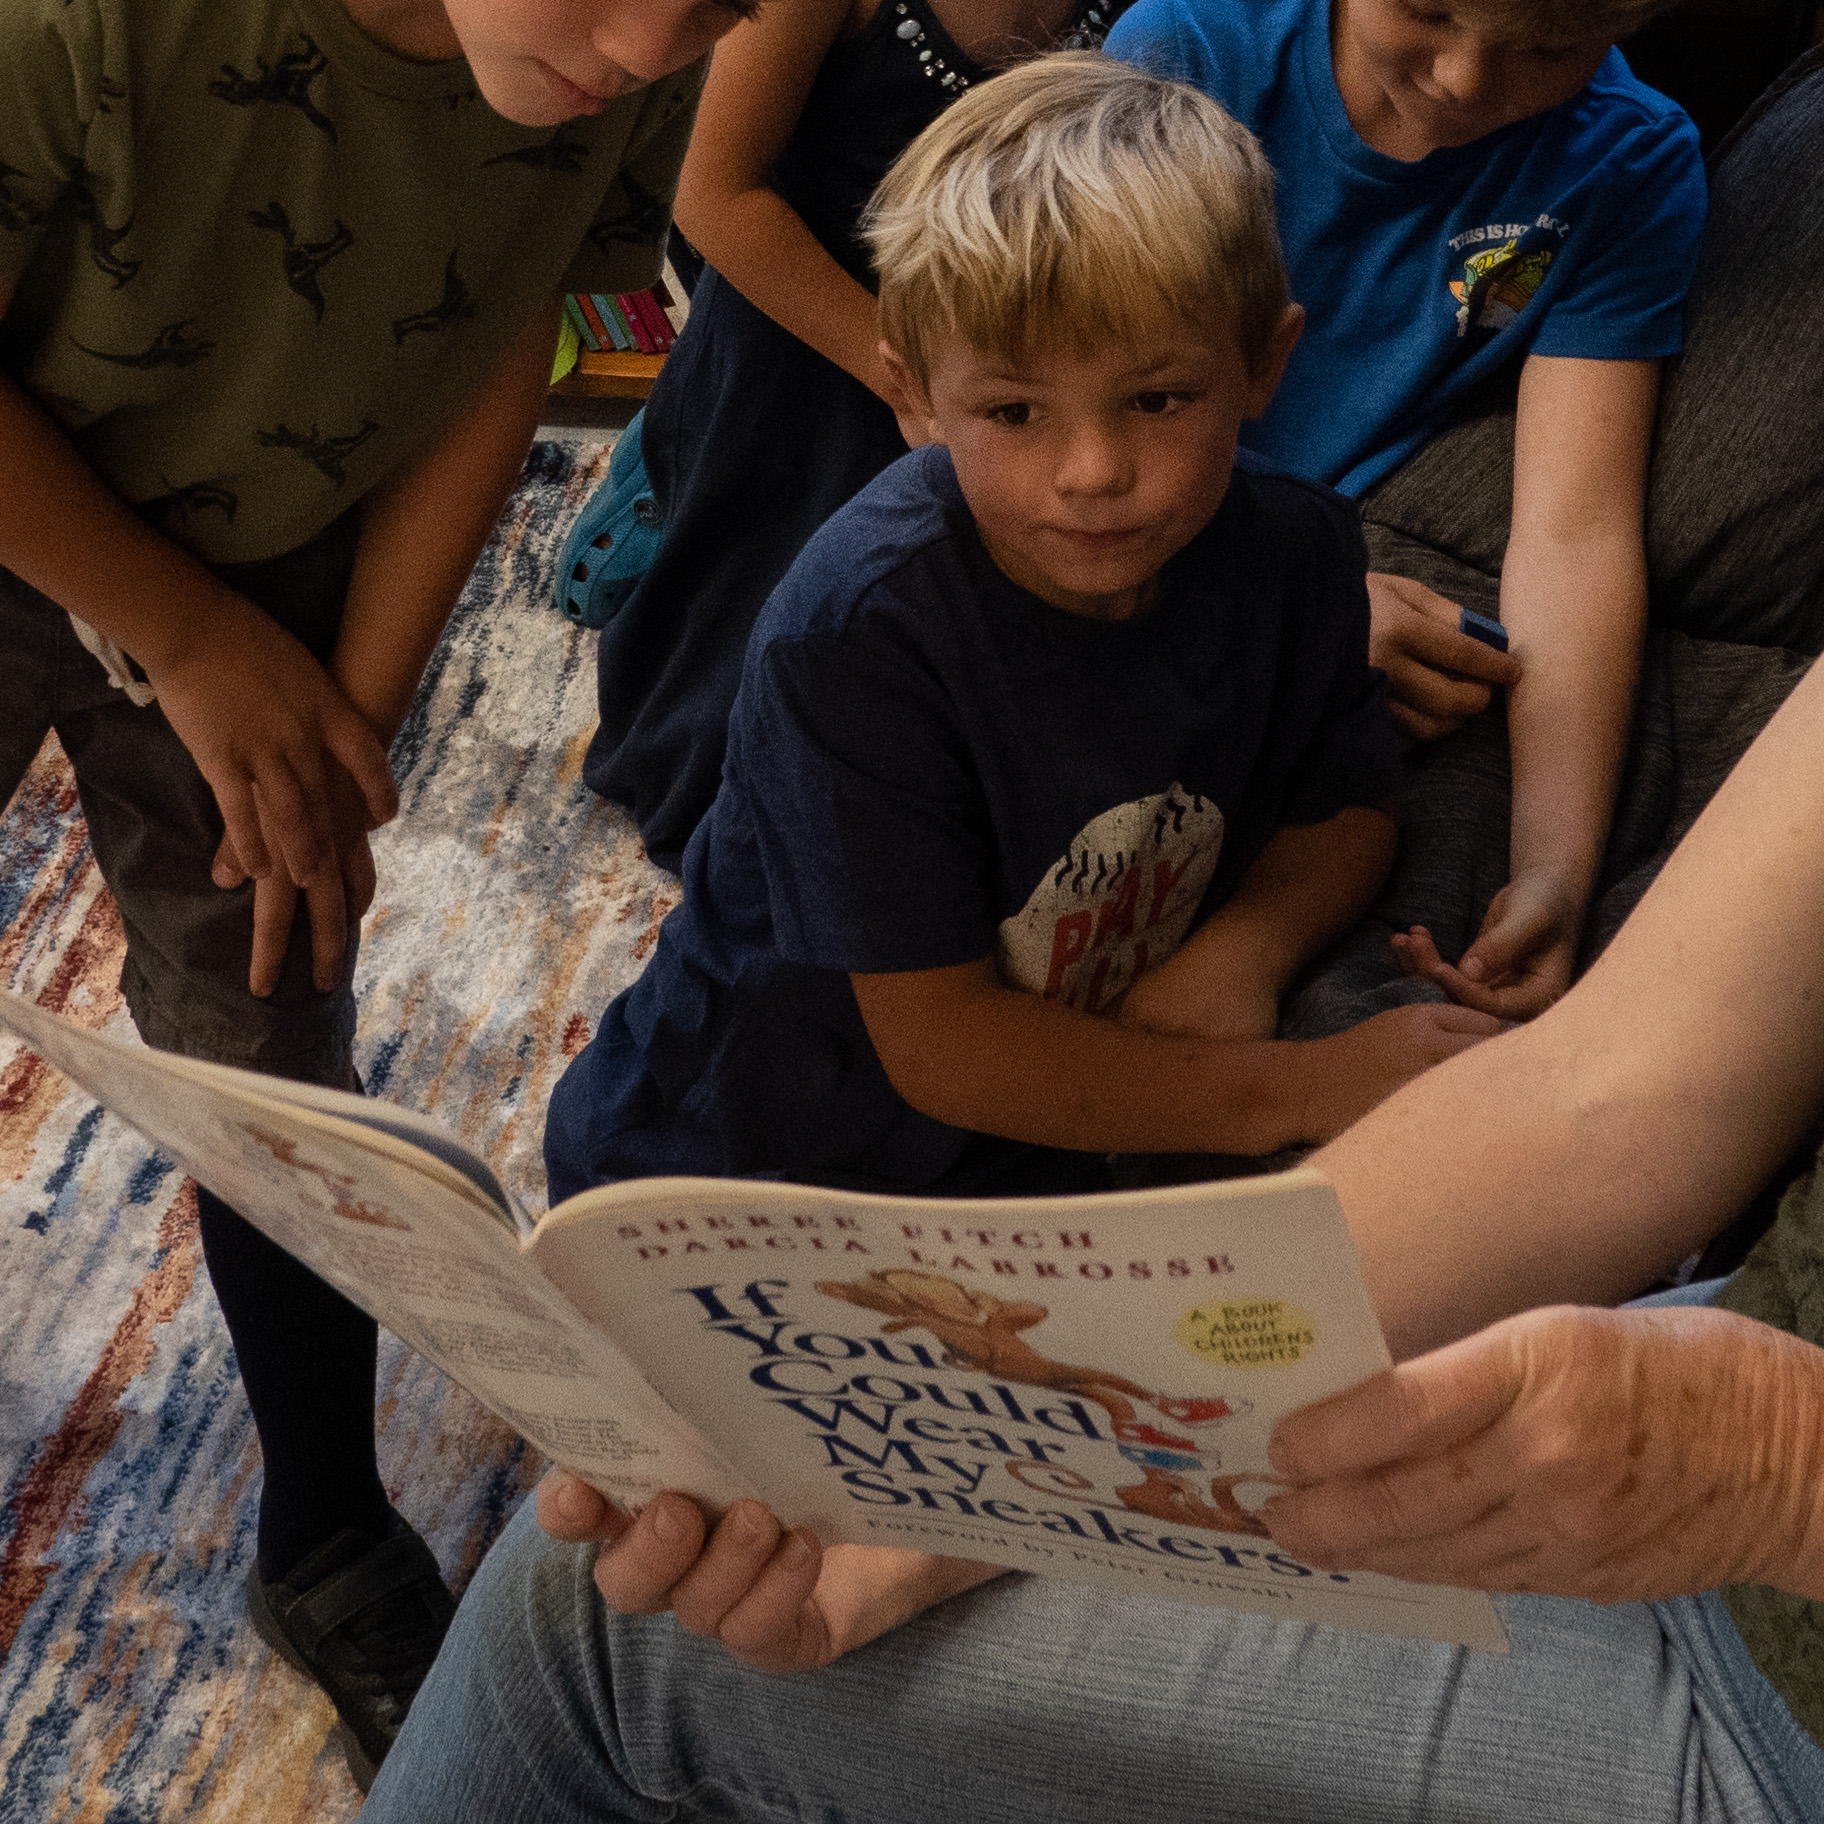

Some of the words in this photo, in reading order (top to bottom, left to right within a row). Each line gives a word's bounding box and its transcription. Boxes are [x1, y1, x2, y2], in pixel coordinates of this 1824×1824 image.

[1447, 226, 1486, 253] THIS
[1486, 223, 1504, 240] IS
[616, 1213, 858, 1241] SHEREE
[900, 1223, 1096, 1251] FITCH
[636, 1236, 871, 1260] DARCIA
[907, 1247, 1237, 1281] LABROSSE
[676, 1278, 800, 1323] If
[1190, 1309, 1208, 1323] A
[1222, 1302, 1283, 1319] BOOK
[702, 1320, 954, 1371] You
[1210, 1319, 1276, 1335] ABOUT
[1222, 1346, 1300, 1366] RIGHTS
[747, 1358, 1122, 1444] Could
[763, 1397, 1067, 1465] Wear
[806, 1433, 993, 1495] My
[865, 1518, 1009, 1547] Foreword
[1023, 1541, 1056, 1559] by
[1073, 1551, 1148, 1576] Peter
